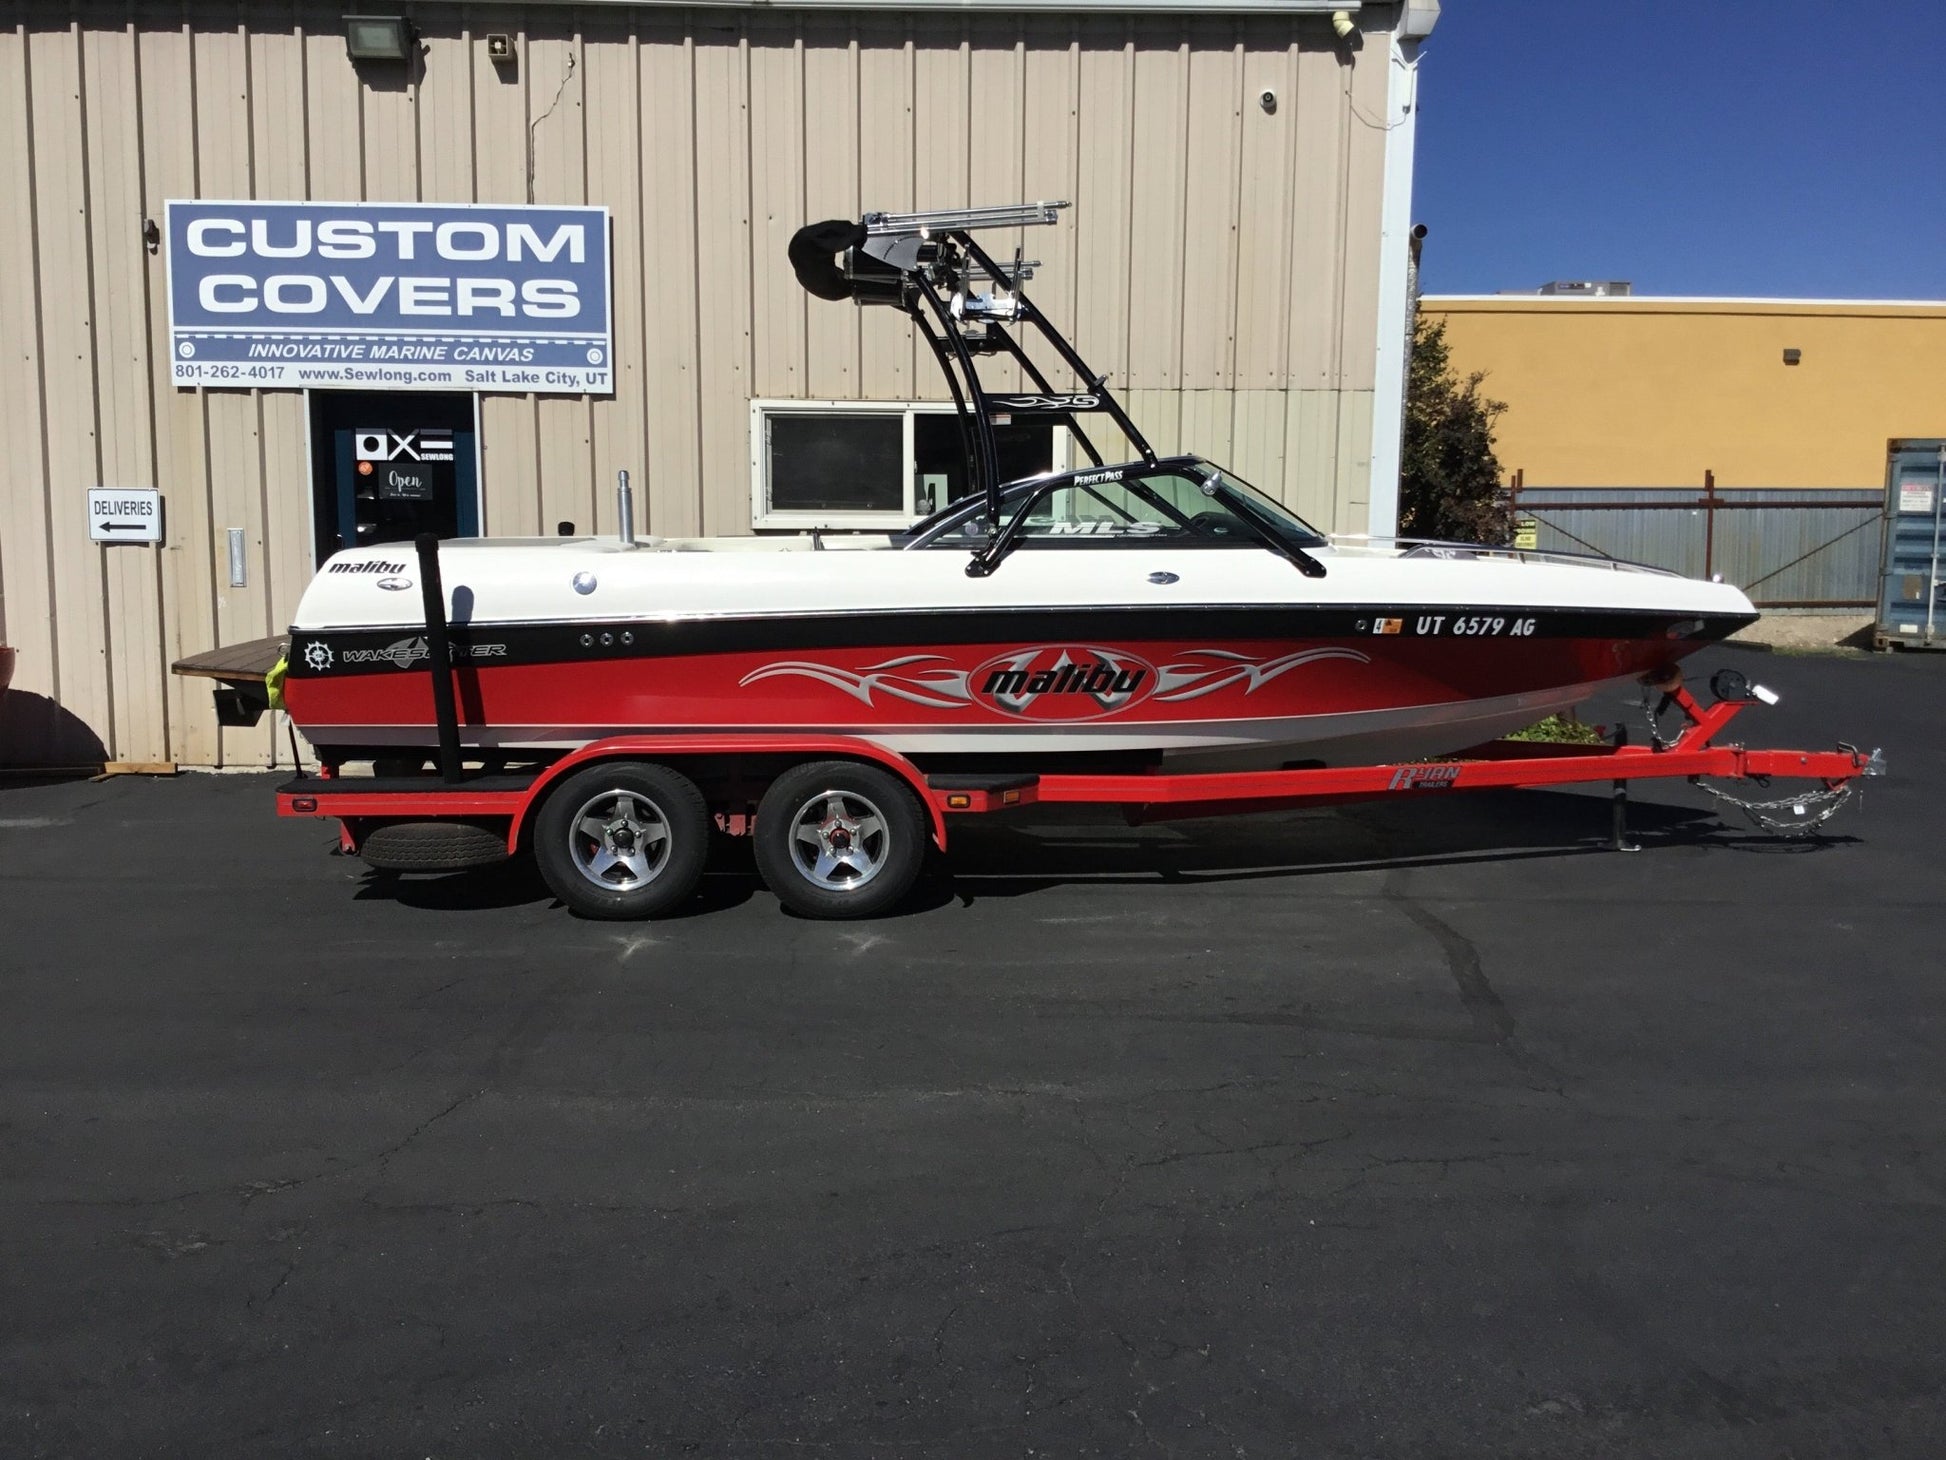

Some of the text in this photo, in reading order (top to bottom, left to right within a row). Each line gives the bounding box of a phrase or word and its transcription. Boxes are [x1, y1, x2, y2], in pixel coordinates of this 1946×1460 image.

[187, 218, 585, 264] CUSTOM
[198, 274, 581, 319] COVERS
[248, 343, 535, 362] INNOVATIVE MARINE CANVAS
[175, 364, 608, 387] 801-262-4017 www.Sewlong.com Salt Lake City, UT
[420, 453, 454, 461] SEWLONG
[389, 470, 422, 492] Open
[94, 500, 153, 516] DELIVERIES
[328, 560, 407, 574] malibu
[1416, 616, 1537, 636] UT 6579 AG
[981, 663, 1148, 694] malibu
